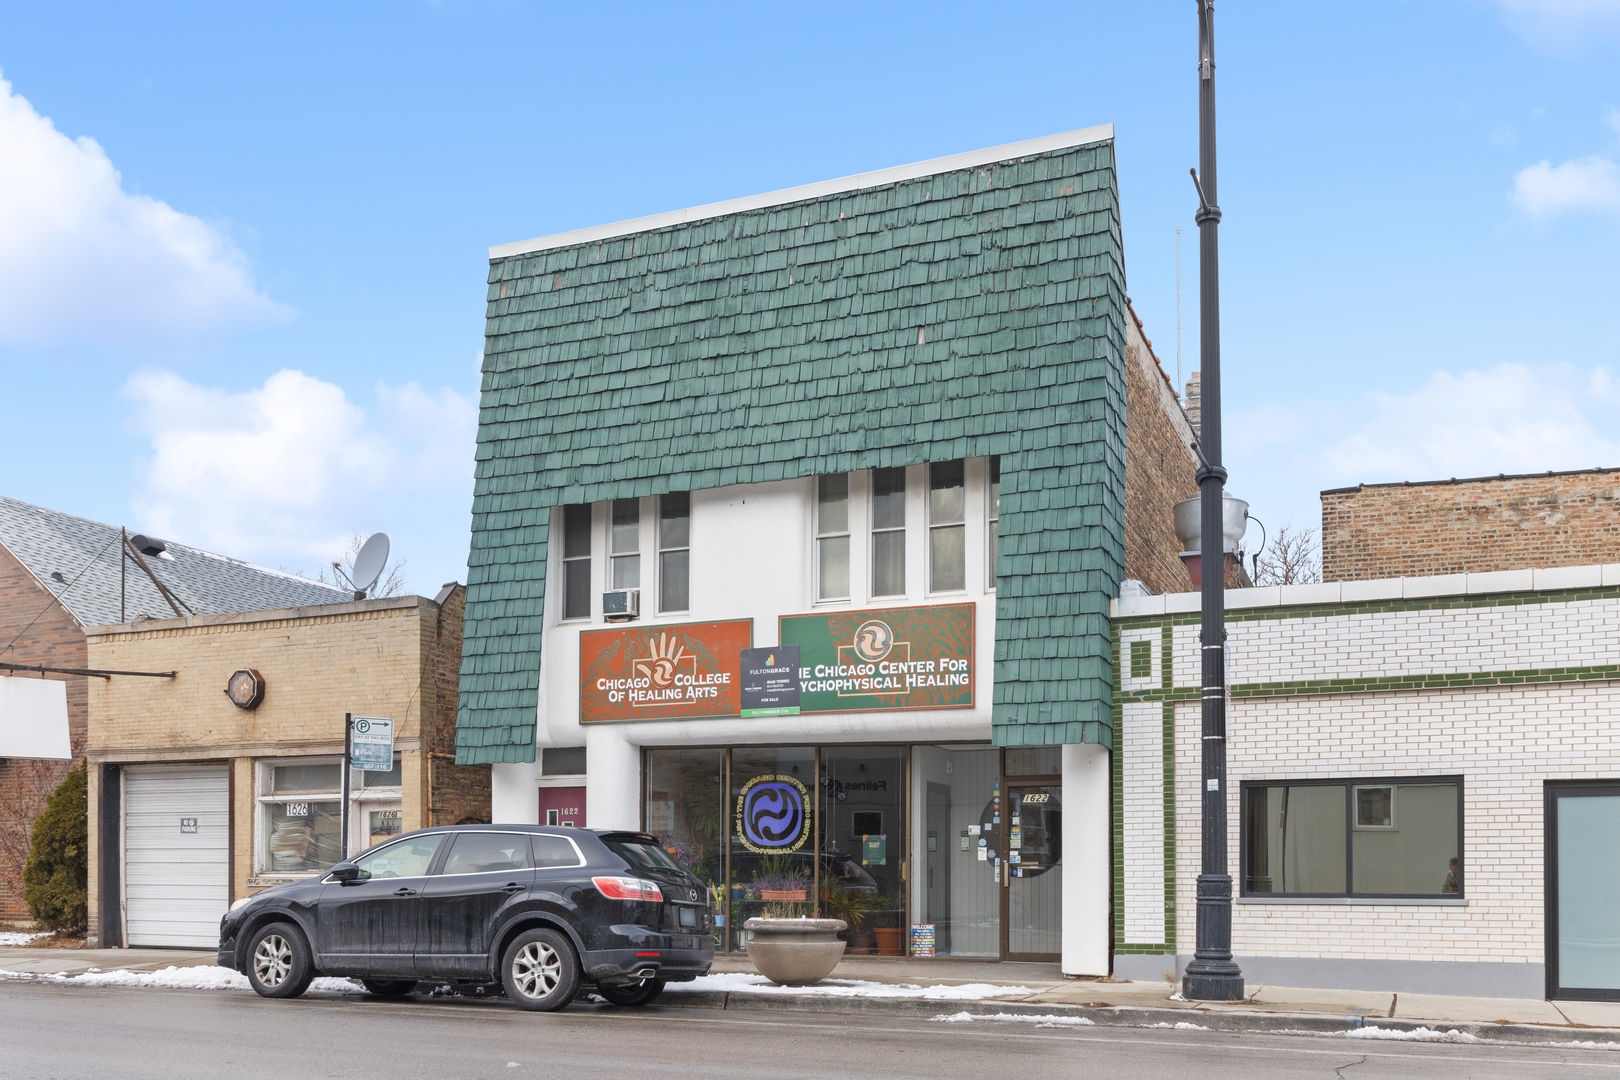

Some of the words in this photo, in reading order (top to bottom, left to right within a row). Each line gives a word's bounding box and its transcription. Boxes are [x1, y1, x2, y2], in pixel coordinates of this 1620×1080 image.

[749, 667, 790, 675] FULTONGRACE
[814, 664, 875, 678] CHICAGO
[878, 660, 935, 676] CENTER
[939, 658, 968, 672] FOR
[596, 677, 650, 690] CHICAGO
[674, 673, 731, 686] COLLEGE
[799, 676, 902, 692] YCHOPHYSICAL
[905, 673, 969, 687] HEALING
[608, 690, 626, 702] OF
[628, 689, 682, 702] HEALING
[686, 686, 718, 699] ARTS
[776, 774, 807, 794] CENTER
[1025, 794, 1048, 802] 1622
[287, 803, 308, 816] 1626
[561, 807, 579, 816] 1622
